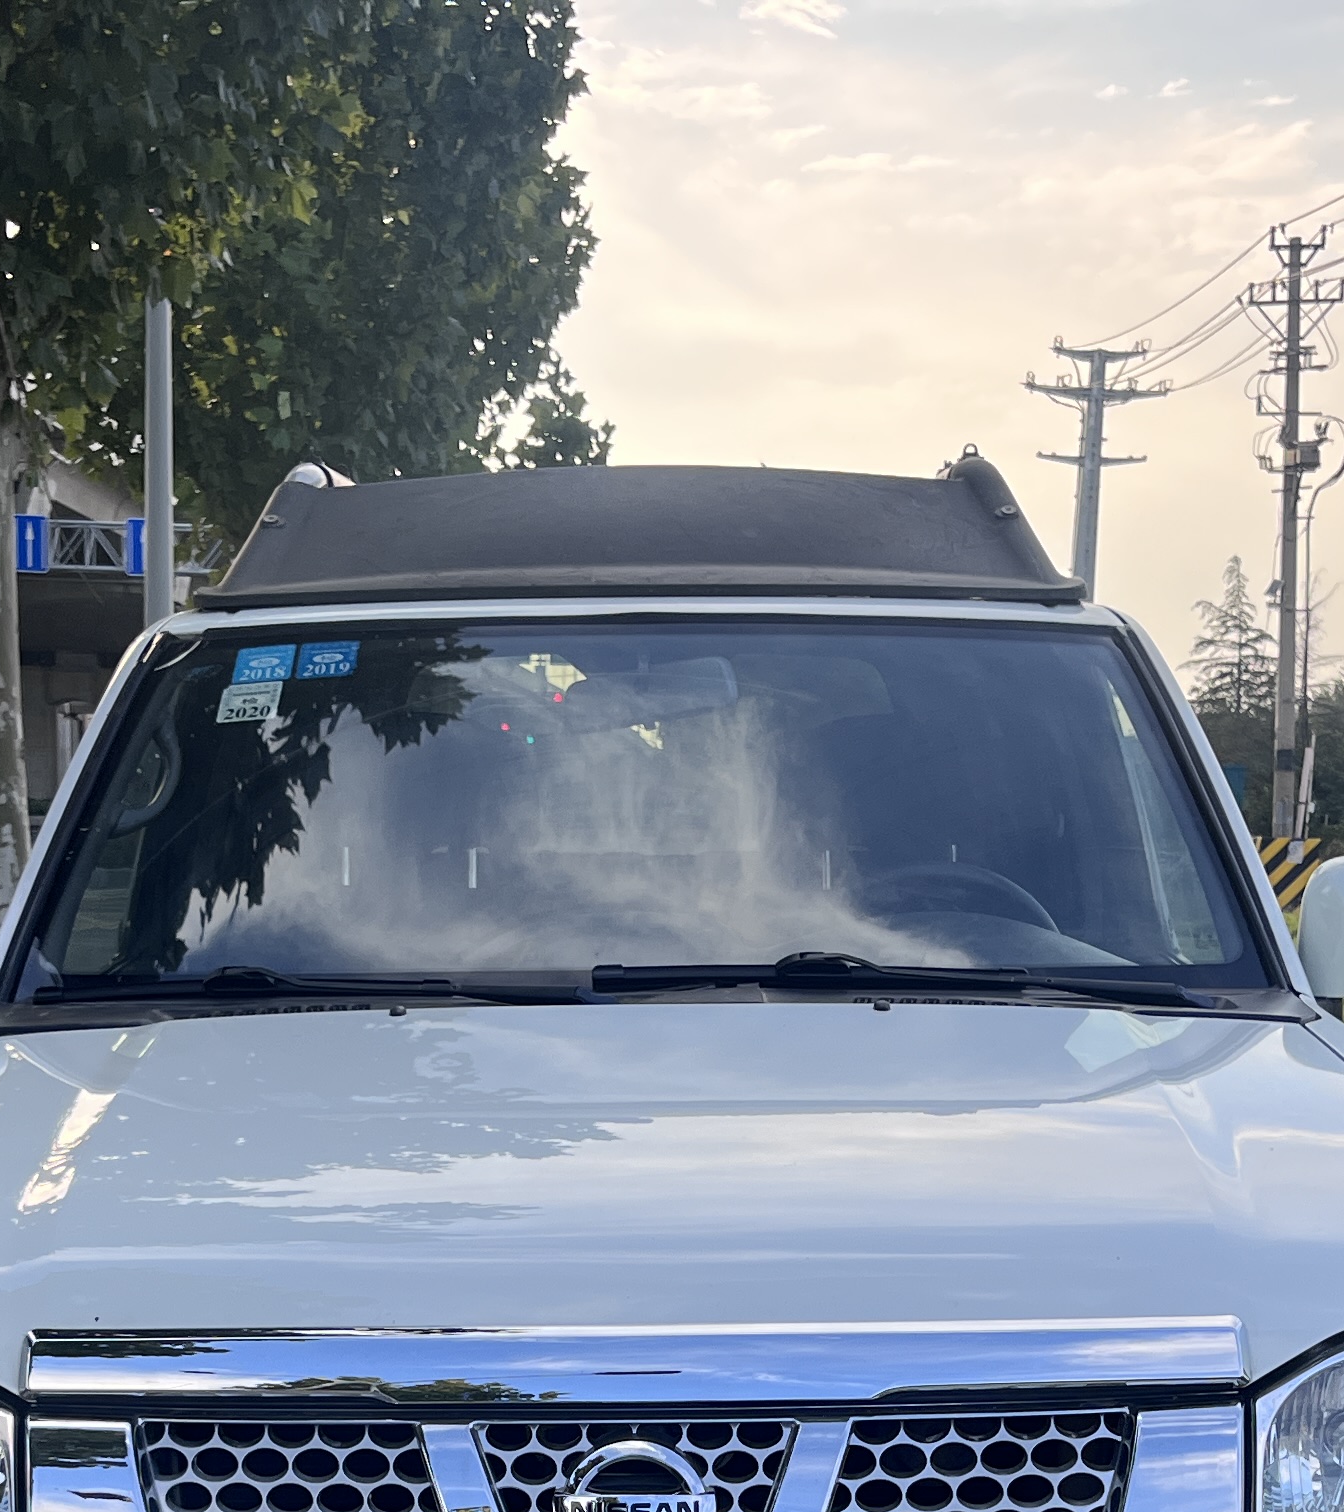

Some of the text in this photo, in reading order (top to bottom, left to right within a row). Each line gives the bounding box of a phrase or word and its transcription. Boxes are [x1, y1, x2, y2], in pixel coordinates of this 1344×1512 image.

[239, 666, 287, 681] 2018
[302, 661, 351, 677] 2019
[223, 705, 271, 720] 2020
